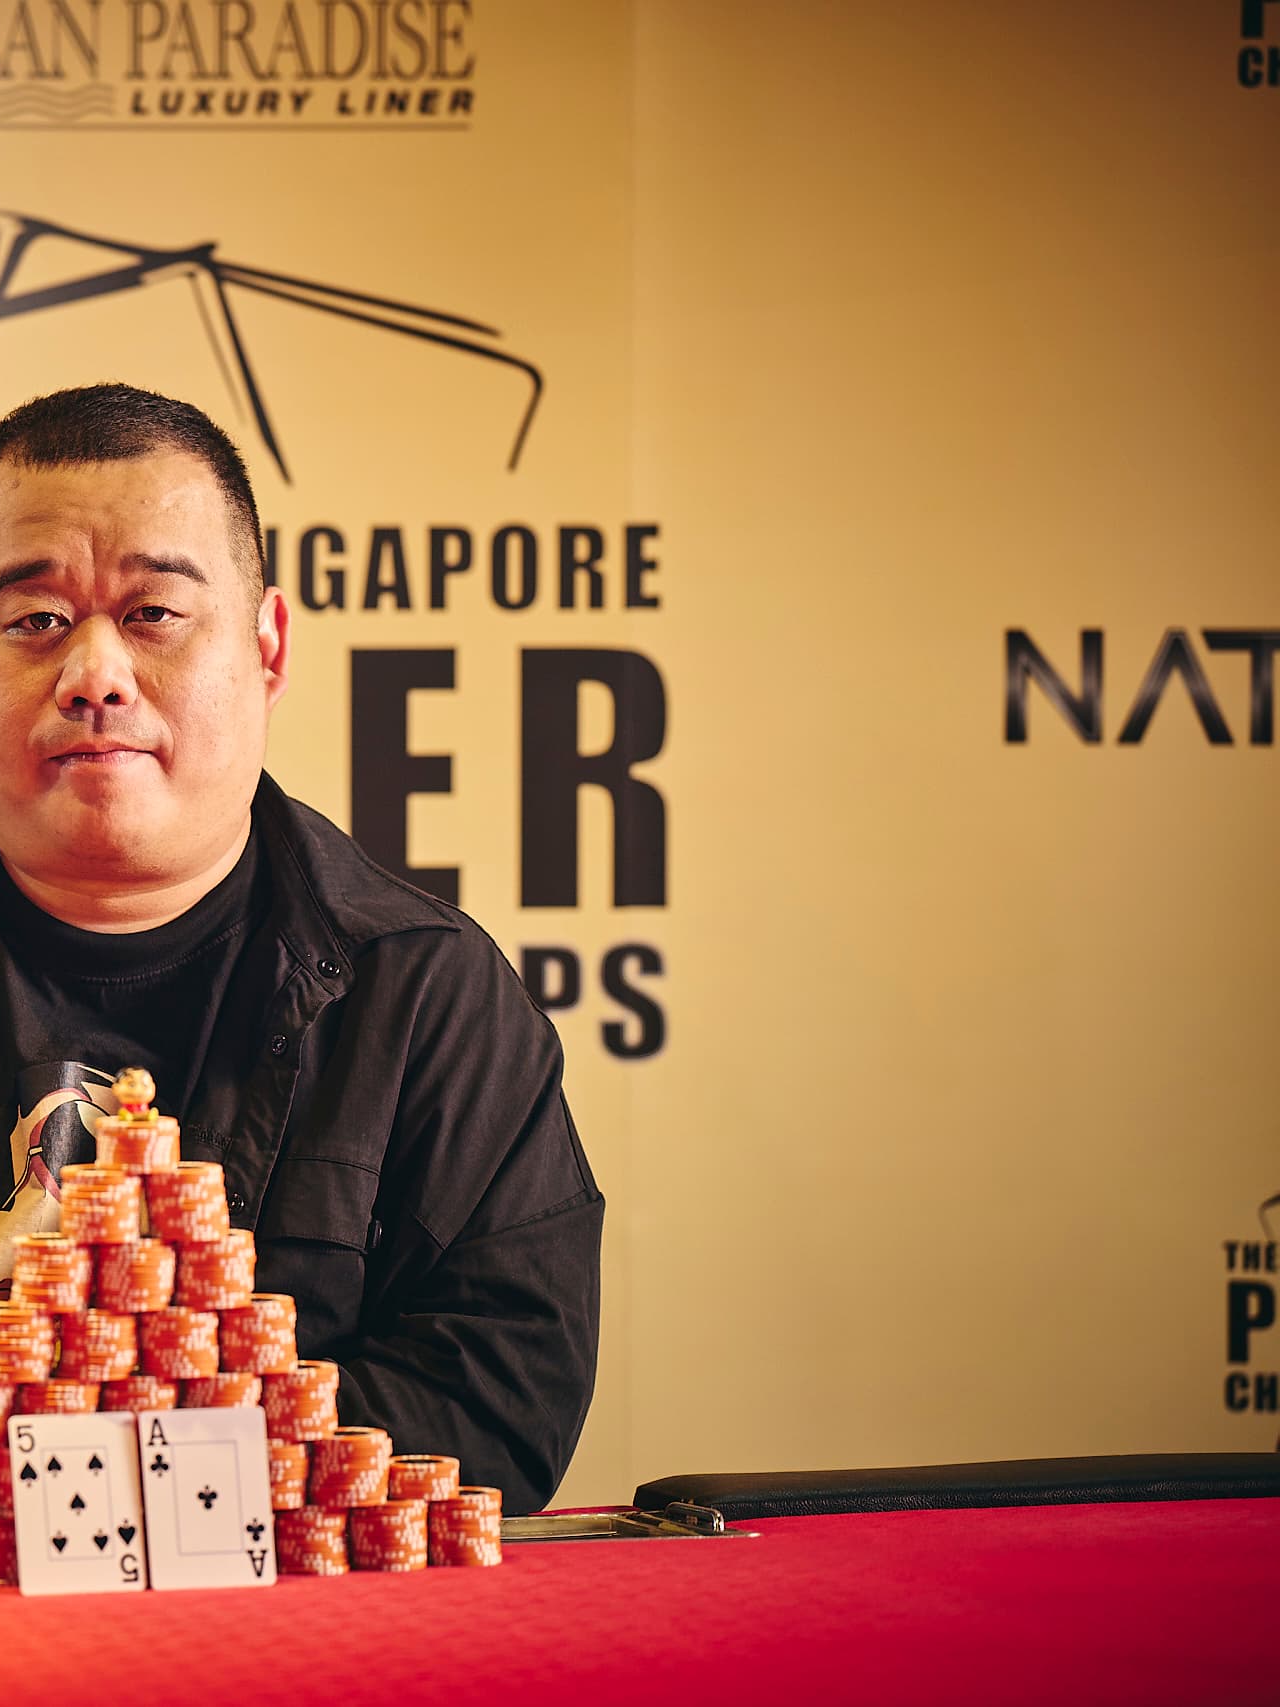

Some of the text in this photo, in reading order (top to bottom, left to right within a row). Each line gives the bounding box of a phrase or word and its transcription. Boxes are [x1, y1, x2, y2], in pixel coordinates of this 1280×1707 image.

[124, 0, 475, 81] PARADISE
[130, 88, 475, 117] LUXURY LINER
[263, 524, 663, 612] GAPORE
[16, 1425, 36, 1453] 5
[148, 1417, 169, 1447] A
[120, 1553, 140, 1583] 5
[247, 1549, 268, 1579] A
